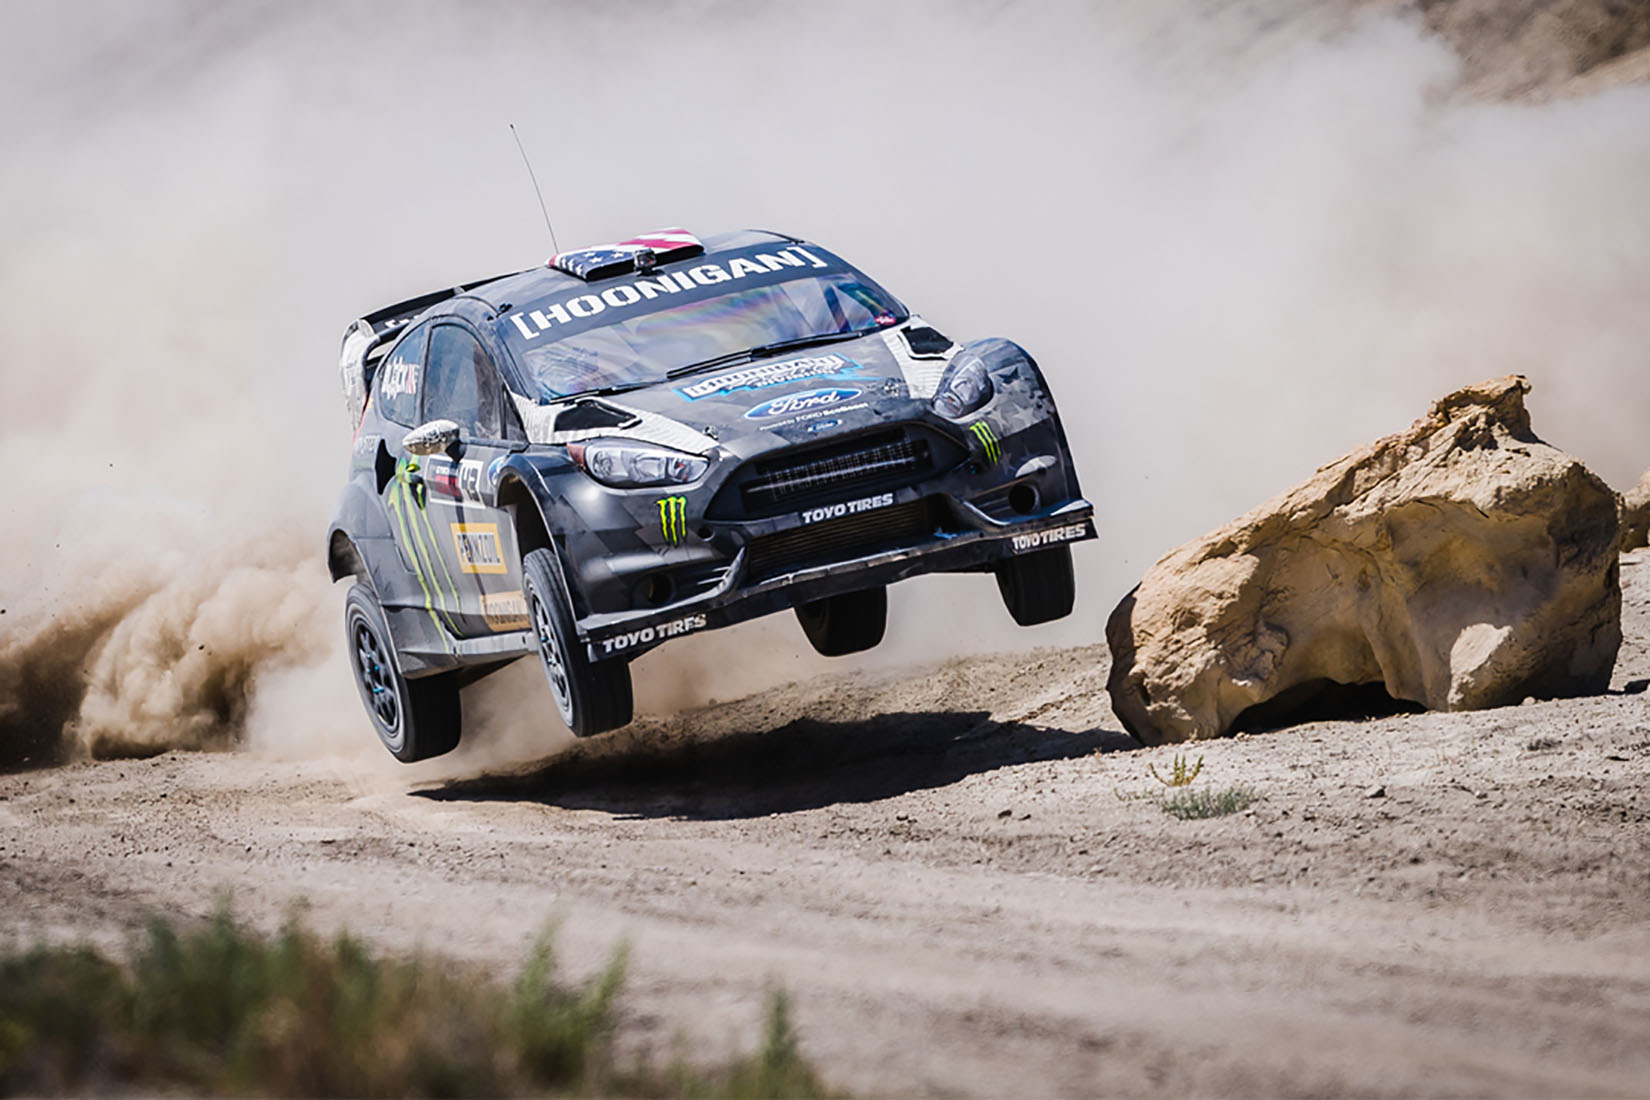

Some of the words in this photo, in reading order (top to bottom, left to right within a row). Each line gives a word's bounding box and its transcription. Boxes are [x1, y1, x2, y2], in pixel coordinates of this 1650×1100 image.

[767, 390, 841, 415] Ford
[802, 504, 847, 524] TOYO
[847, 493, 894, 514] TIRES
[1012, 532, 1041, 550] TOYO
[1040, 522, 1086, 544] TIRES
[603, 627, 654, 653] TOYO
